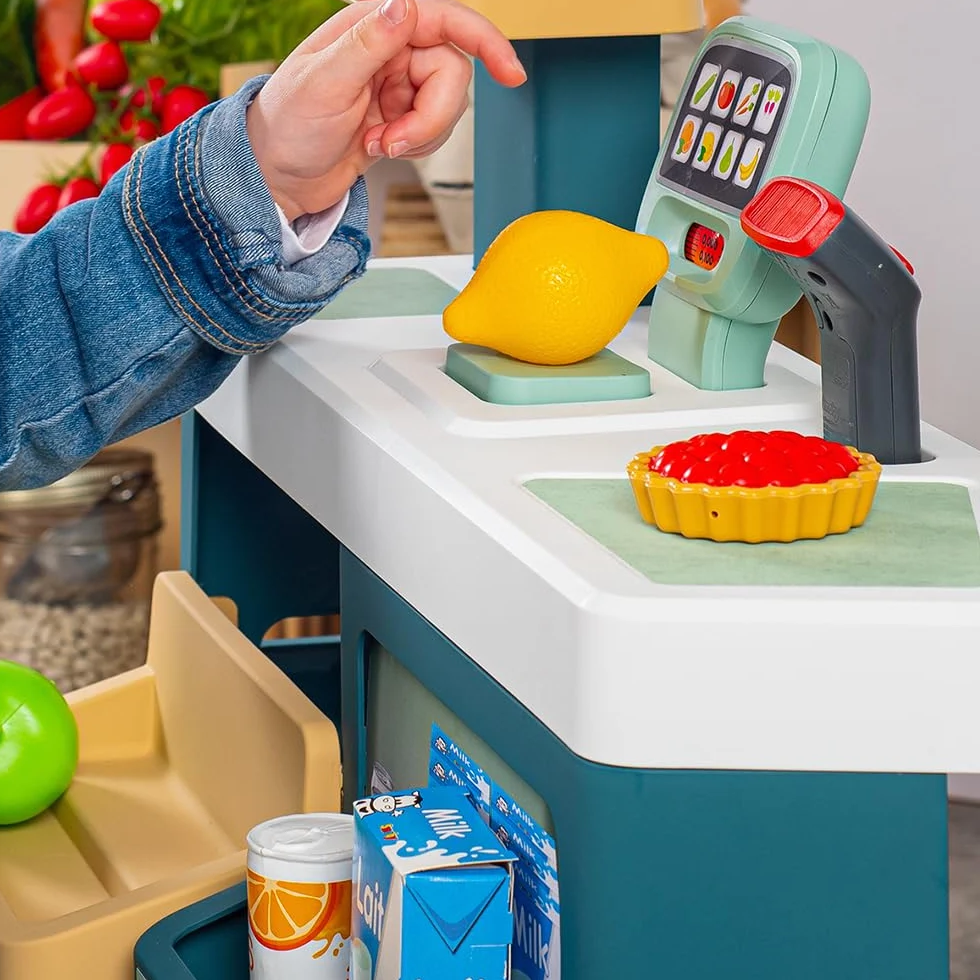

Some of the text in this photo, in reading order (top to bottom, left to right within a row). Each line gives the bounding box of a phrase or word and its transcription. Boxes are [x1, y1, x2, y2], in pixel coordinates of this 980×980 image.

[449, 743, 471, 768] Milk
[421, 808, 472, 840] Milk
[511, 803, 534, 830] Milk
[513, 833, 536, 860] Milk
[356, 855, 385, 942] Lait
[513, 898, 550, 978] Milk
